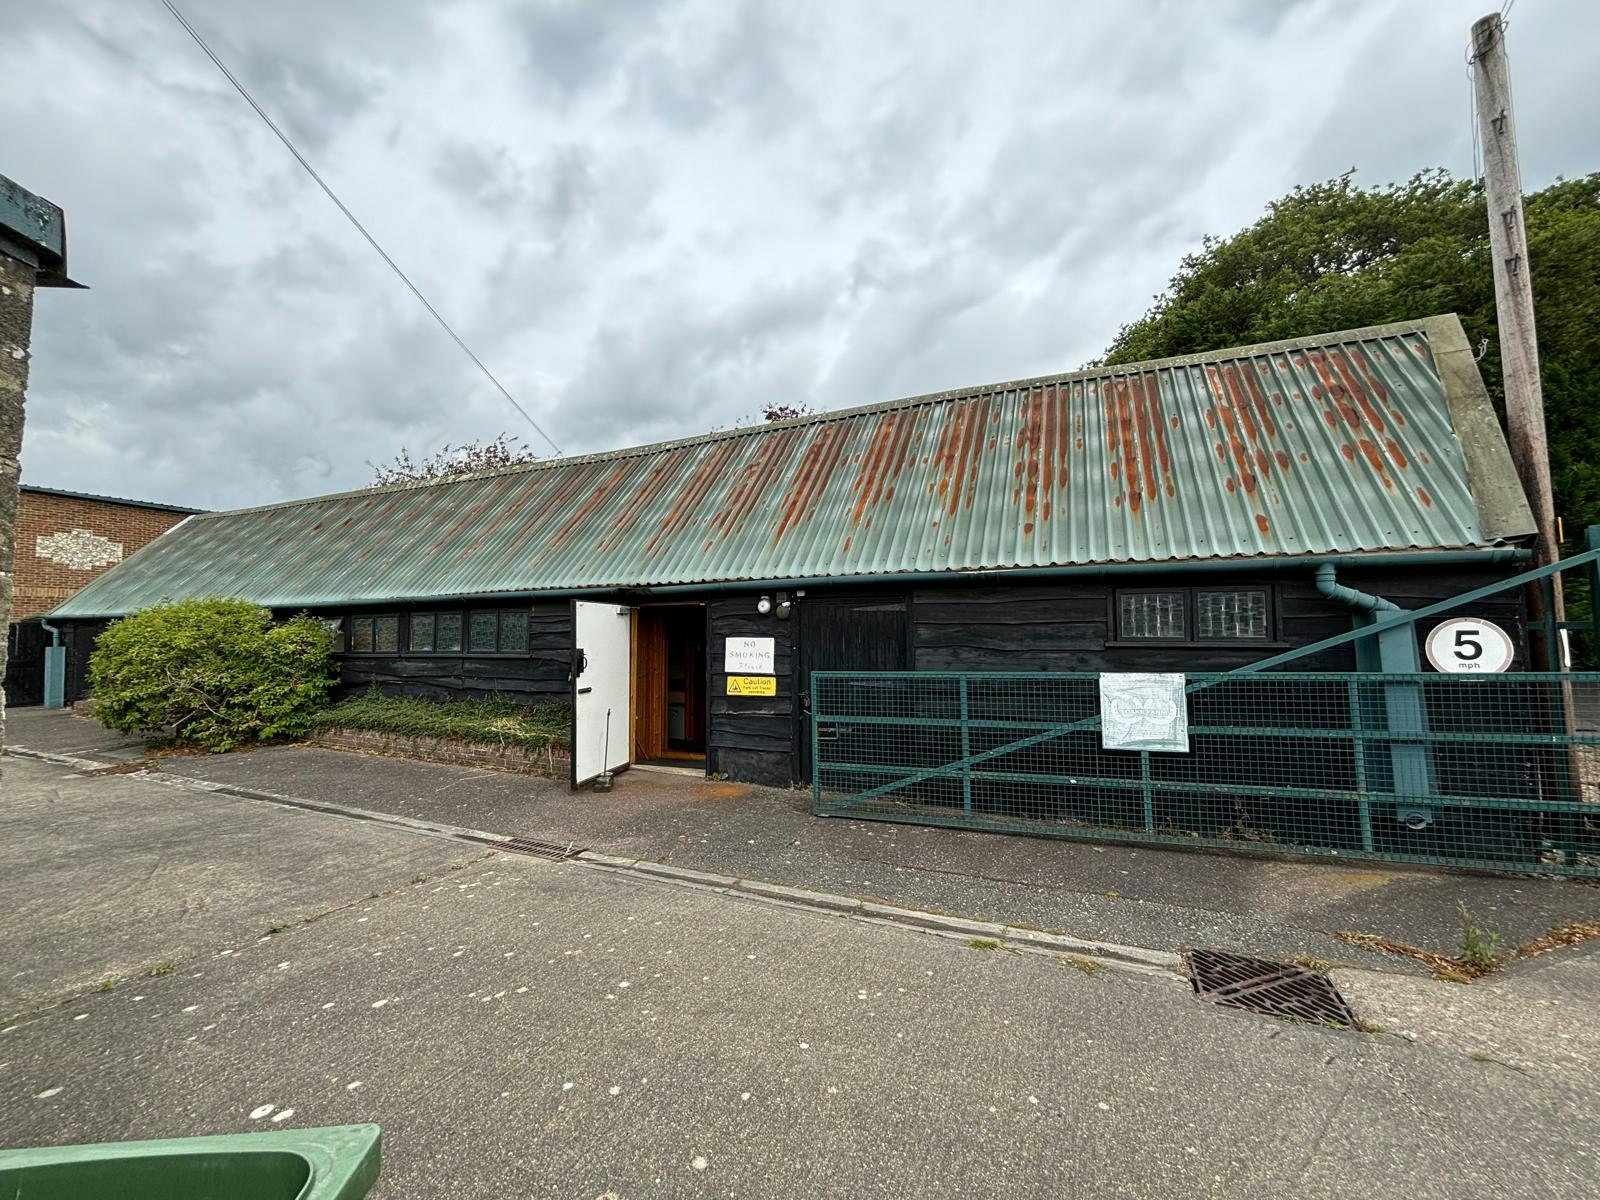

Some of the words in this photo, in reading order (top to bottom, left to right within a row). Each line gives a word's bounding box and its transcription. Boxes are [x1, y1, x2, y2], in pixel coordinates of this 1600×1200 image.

[743, 640, 756, 648] NO
[1454, 630, 1482, 660] 5
[729, 650, 770, 659] SMOKING
[1458, 662, 1480, 670] mph
[743, 677, 771, 685] Caution
